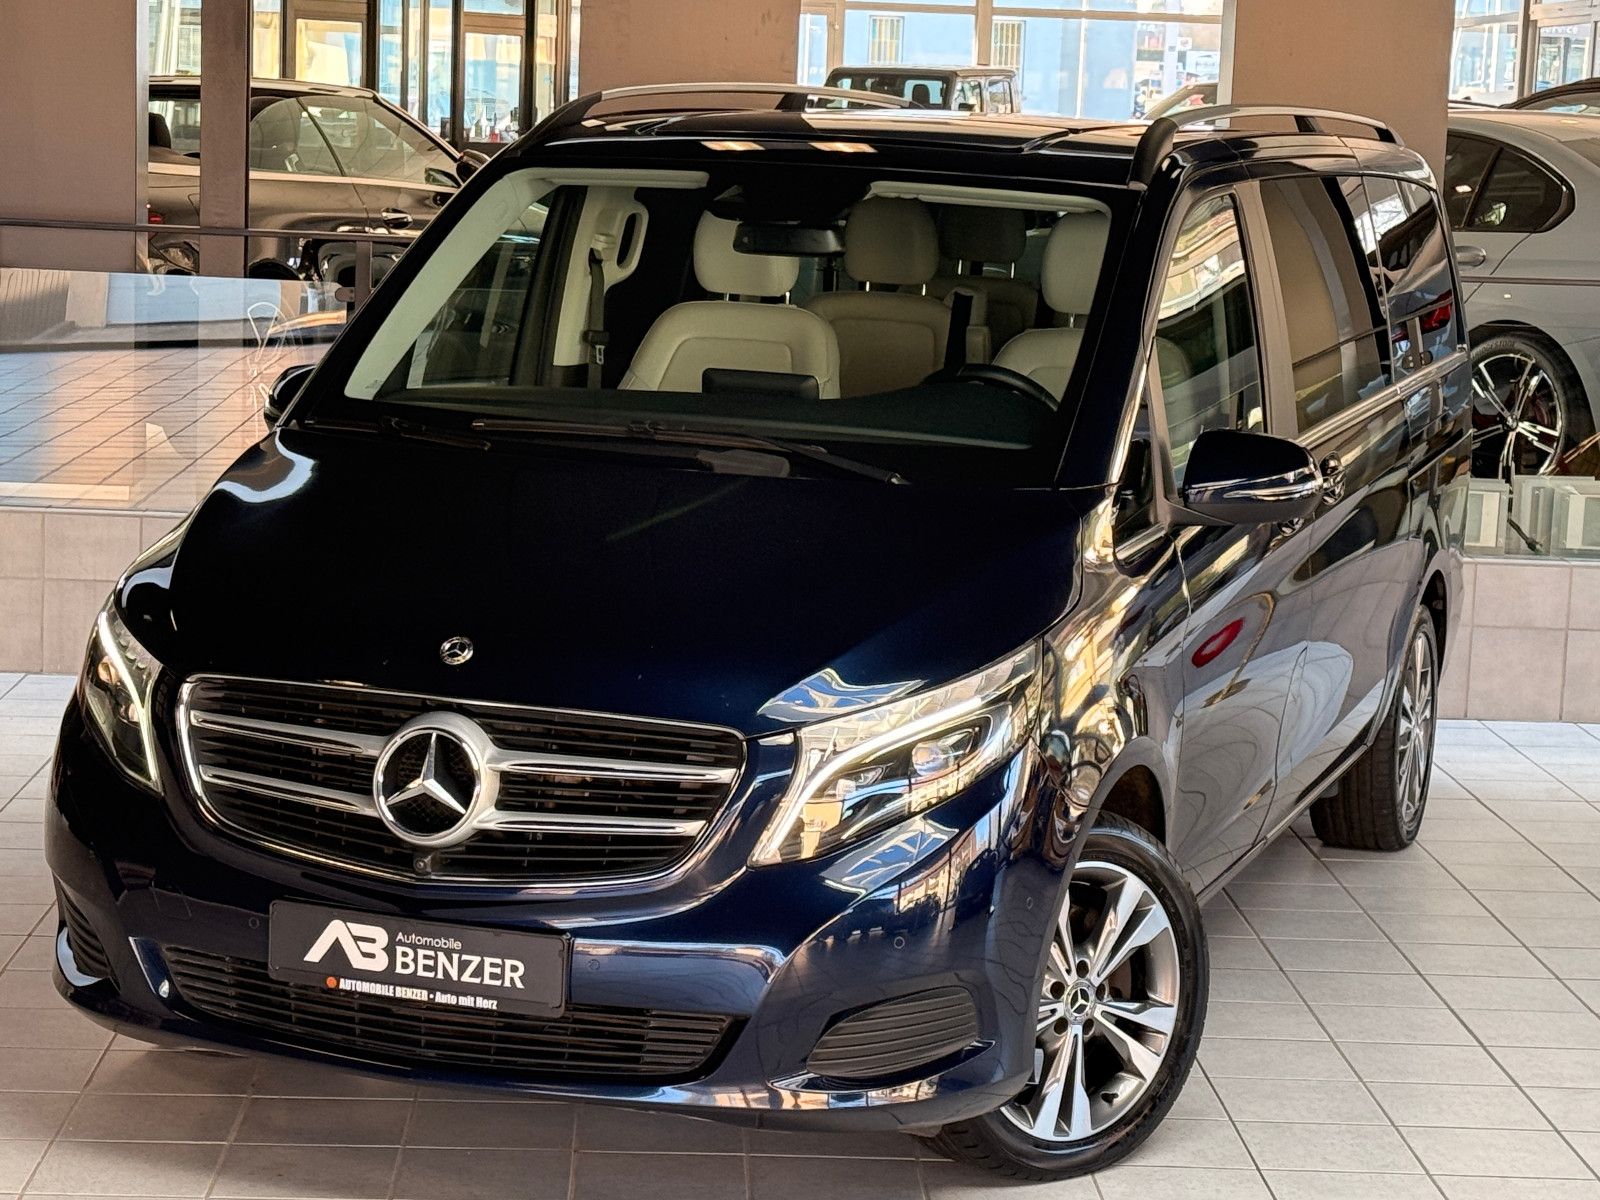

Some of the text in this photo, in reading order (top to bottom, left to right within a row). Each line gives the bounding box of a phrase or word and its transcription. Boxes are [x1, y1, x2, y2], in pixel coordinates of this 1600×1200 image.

[395, 931, 462, 950] Automobile
[394, 945, 525, 989] BENZER
[339, 977, 498, 1010] AUTOMOBILE BENZER Auto mit Herz
